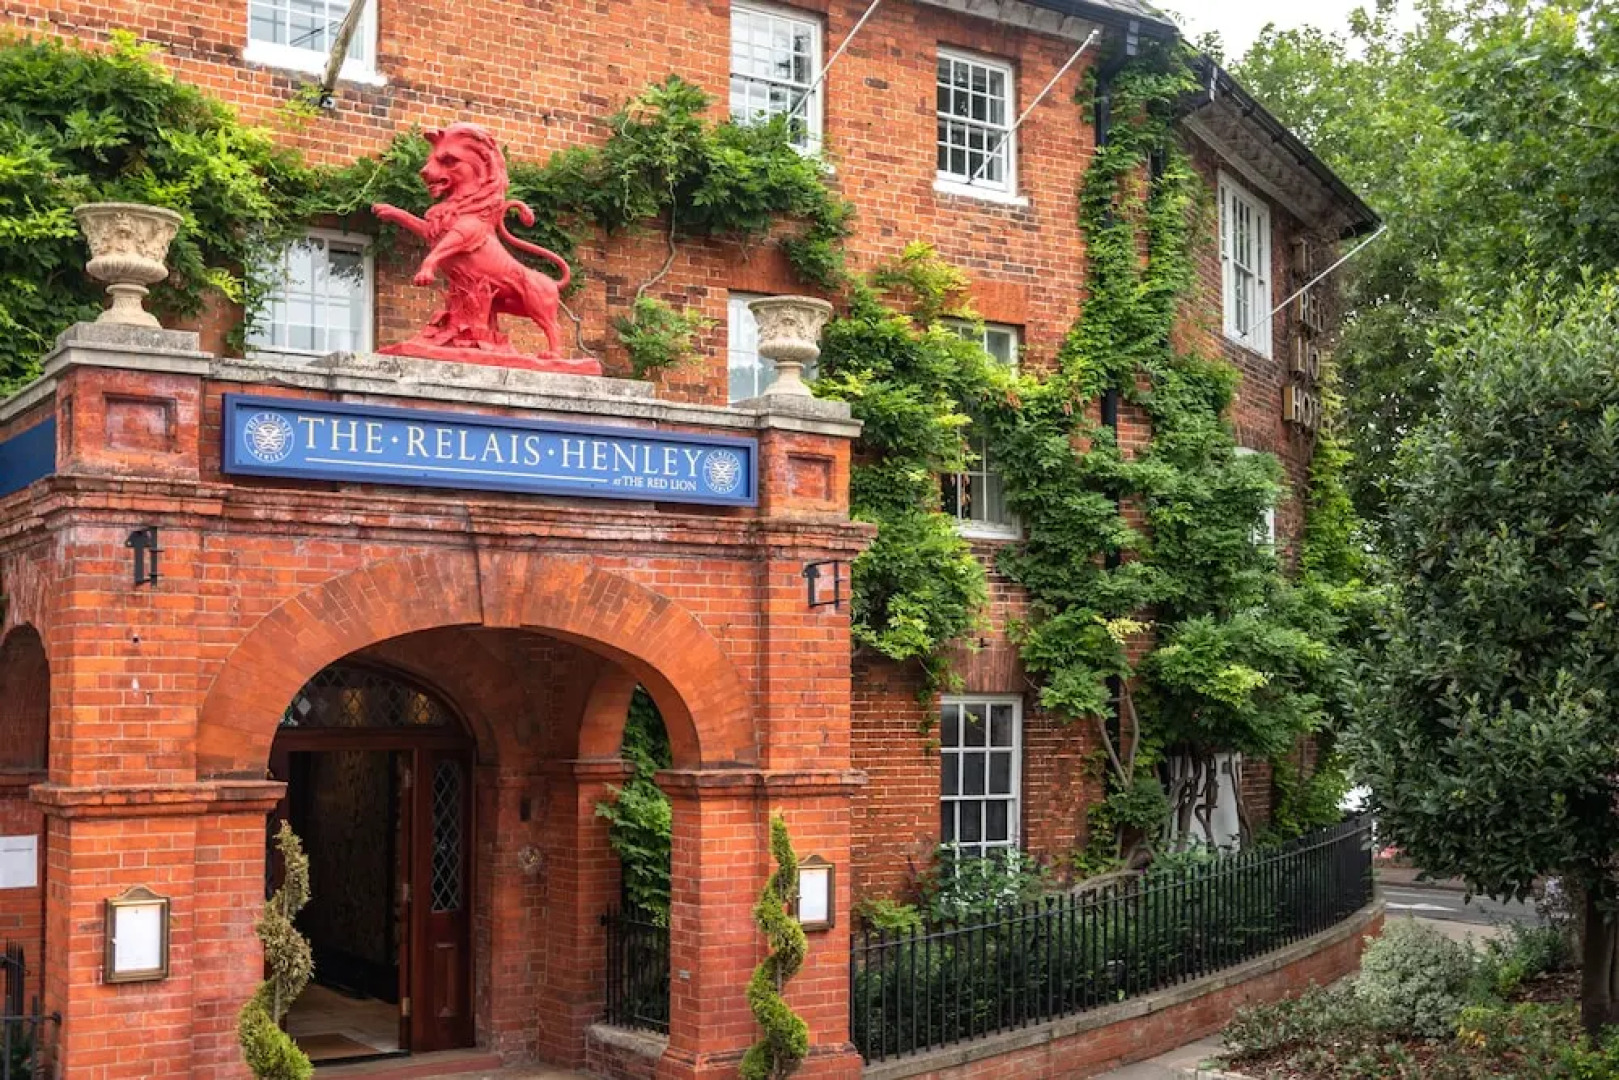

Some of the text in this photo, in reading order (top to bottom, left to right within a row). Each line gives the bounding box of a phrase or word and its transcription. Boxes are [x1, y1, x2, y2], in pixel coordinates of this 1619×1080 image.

[297, 415, 383, 454] THE
[406, 425, 540, 466] RELAIS
[561, 438, 704, 477] HENLEY
[622, 476, 644, 488] THE
[647, 477, 668, 489] RED
[670, 479, 697, 491] LION
